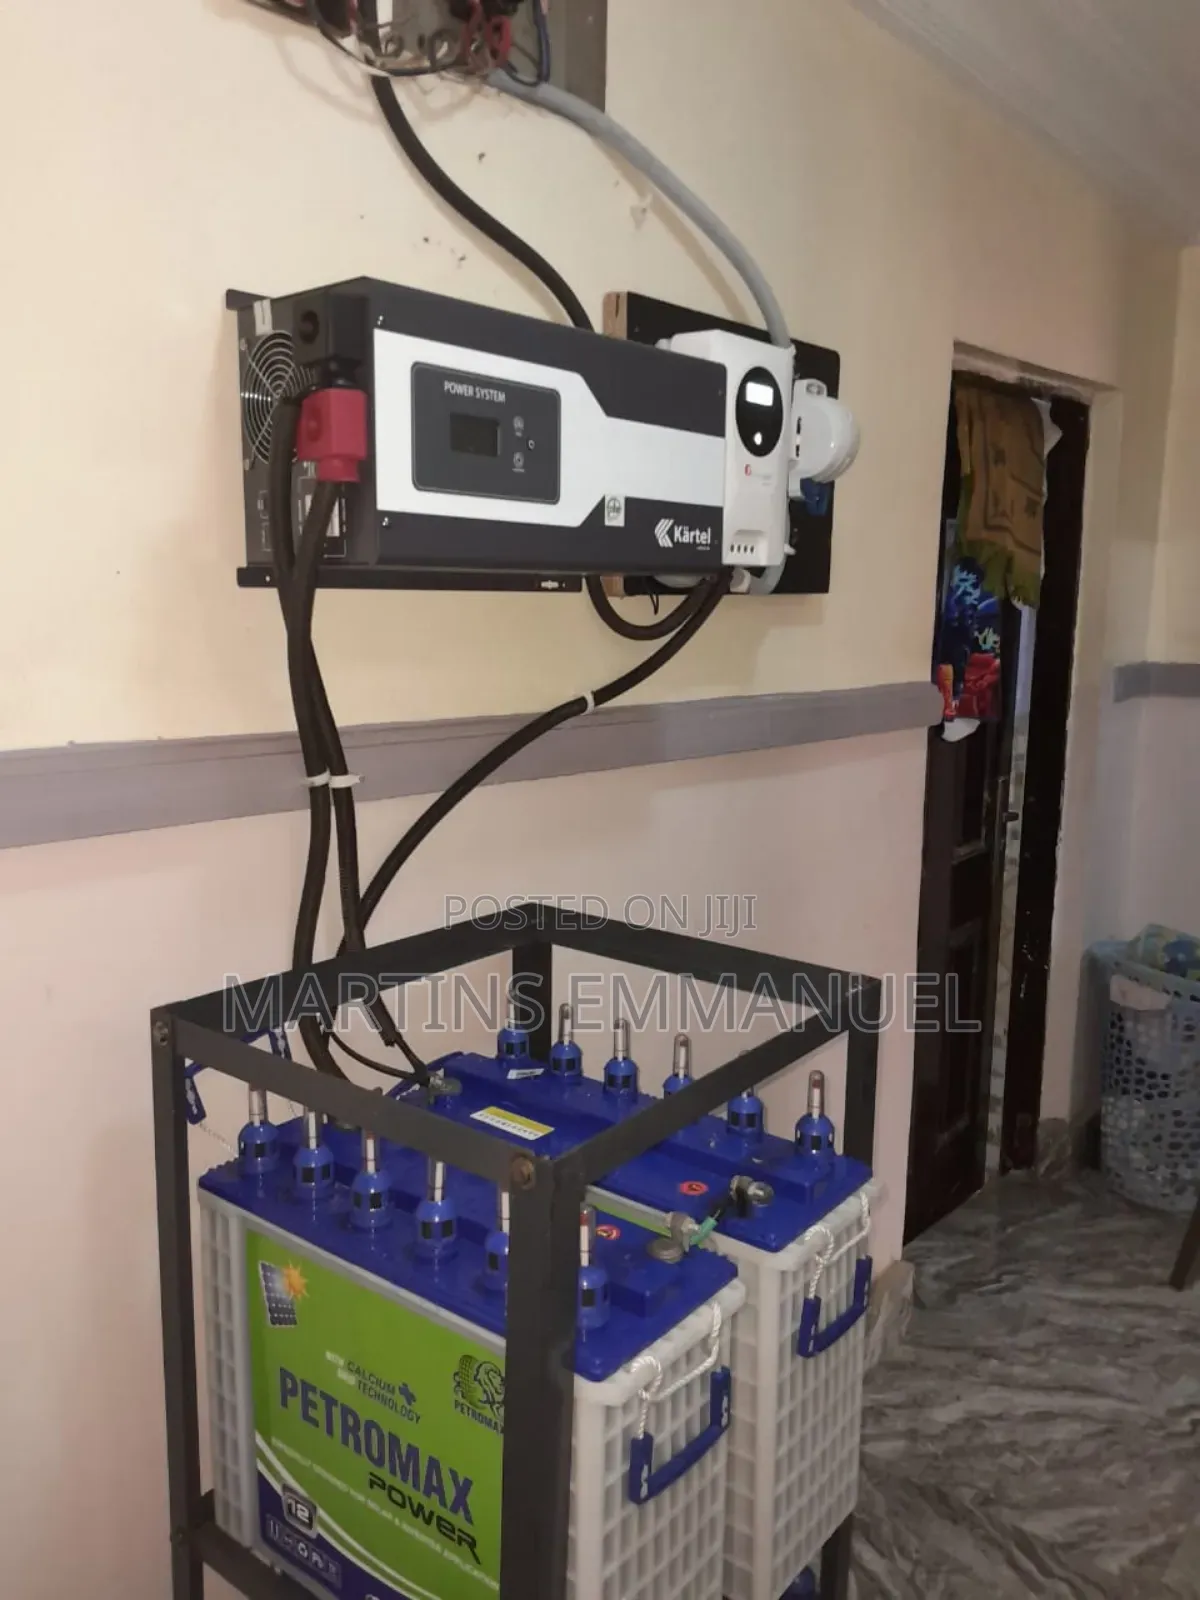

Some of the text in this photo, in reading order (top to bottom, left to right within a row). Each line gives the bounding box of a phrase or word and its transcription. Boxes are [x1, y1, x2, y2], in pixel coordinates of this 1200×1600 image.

[444, 380, 506, 404] POWER SYSTEM
[673, 525, 711, 545] Kärtel
[346, 1360, 396, 1396] CALCIUM
[358, 1379, 421, 1424] TECHNOLOGY
[279, 1366, 474, 1526] PETROMAX
